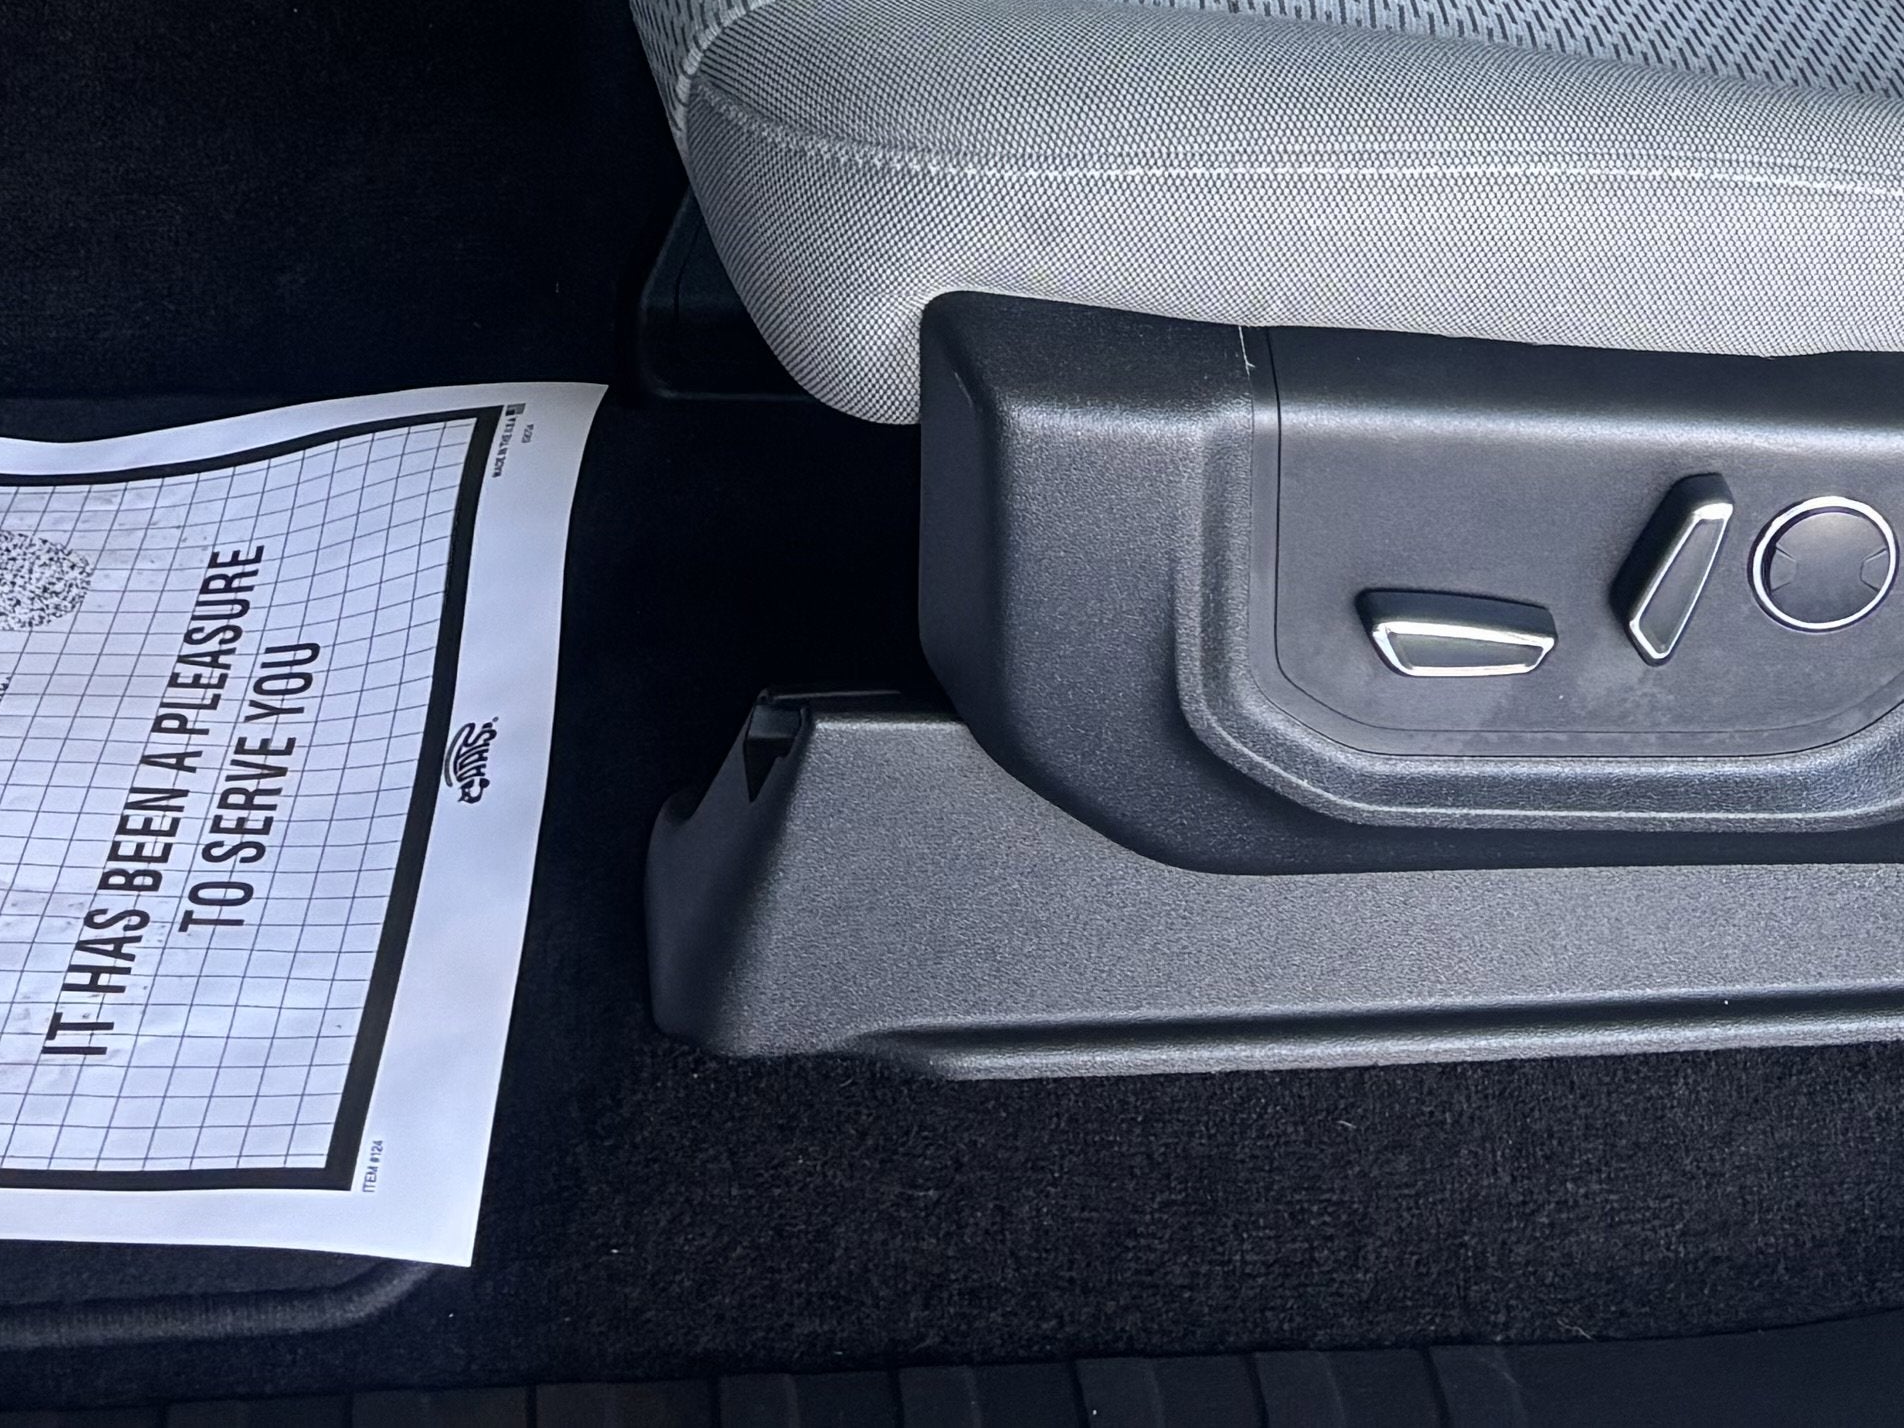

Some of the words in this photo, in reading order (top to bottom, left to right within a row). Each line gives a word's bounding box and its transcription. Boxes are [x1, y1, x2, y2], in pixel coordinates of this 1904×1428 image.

[151, 545, 264, 735] PLEASURE
[244, 642, 321, 723] YOU
[140, 751, 203, 773] A
[201, 737, 296, 864] SERVE
[97, 787, 190, 891] BEEN
[178, 881, 254, 932] TO
[61, 908, 150, 994] HAS
[41, 1012, 115, 1056] IT
[362, 1165, 378, 1192] ITEM
